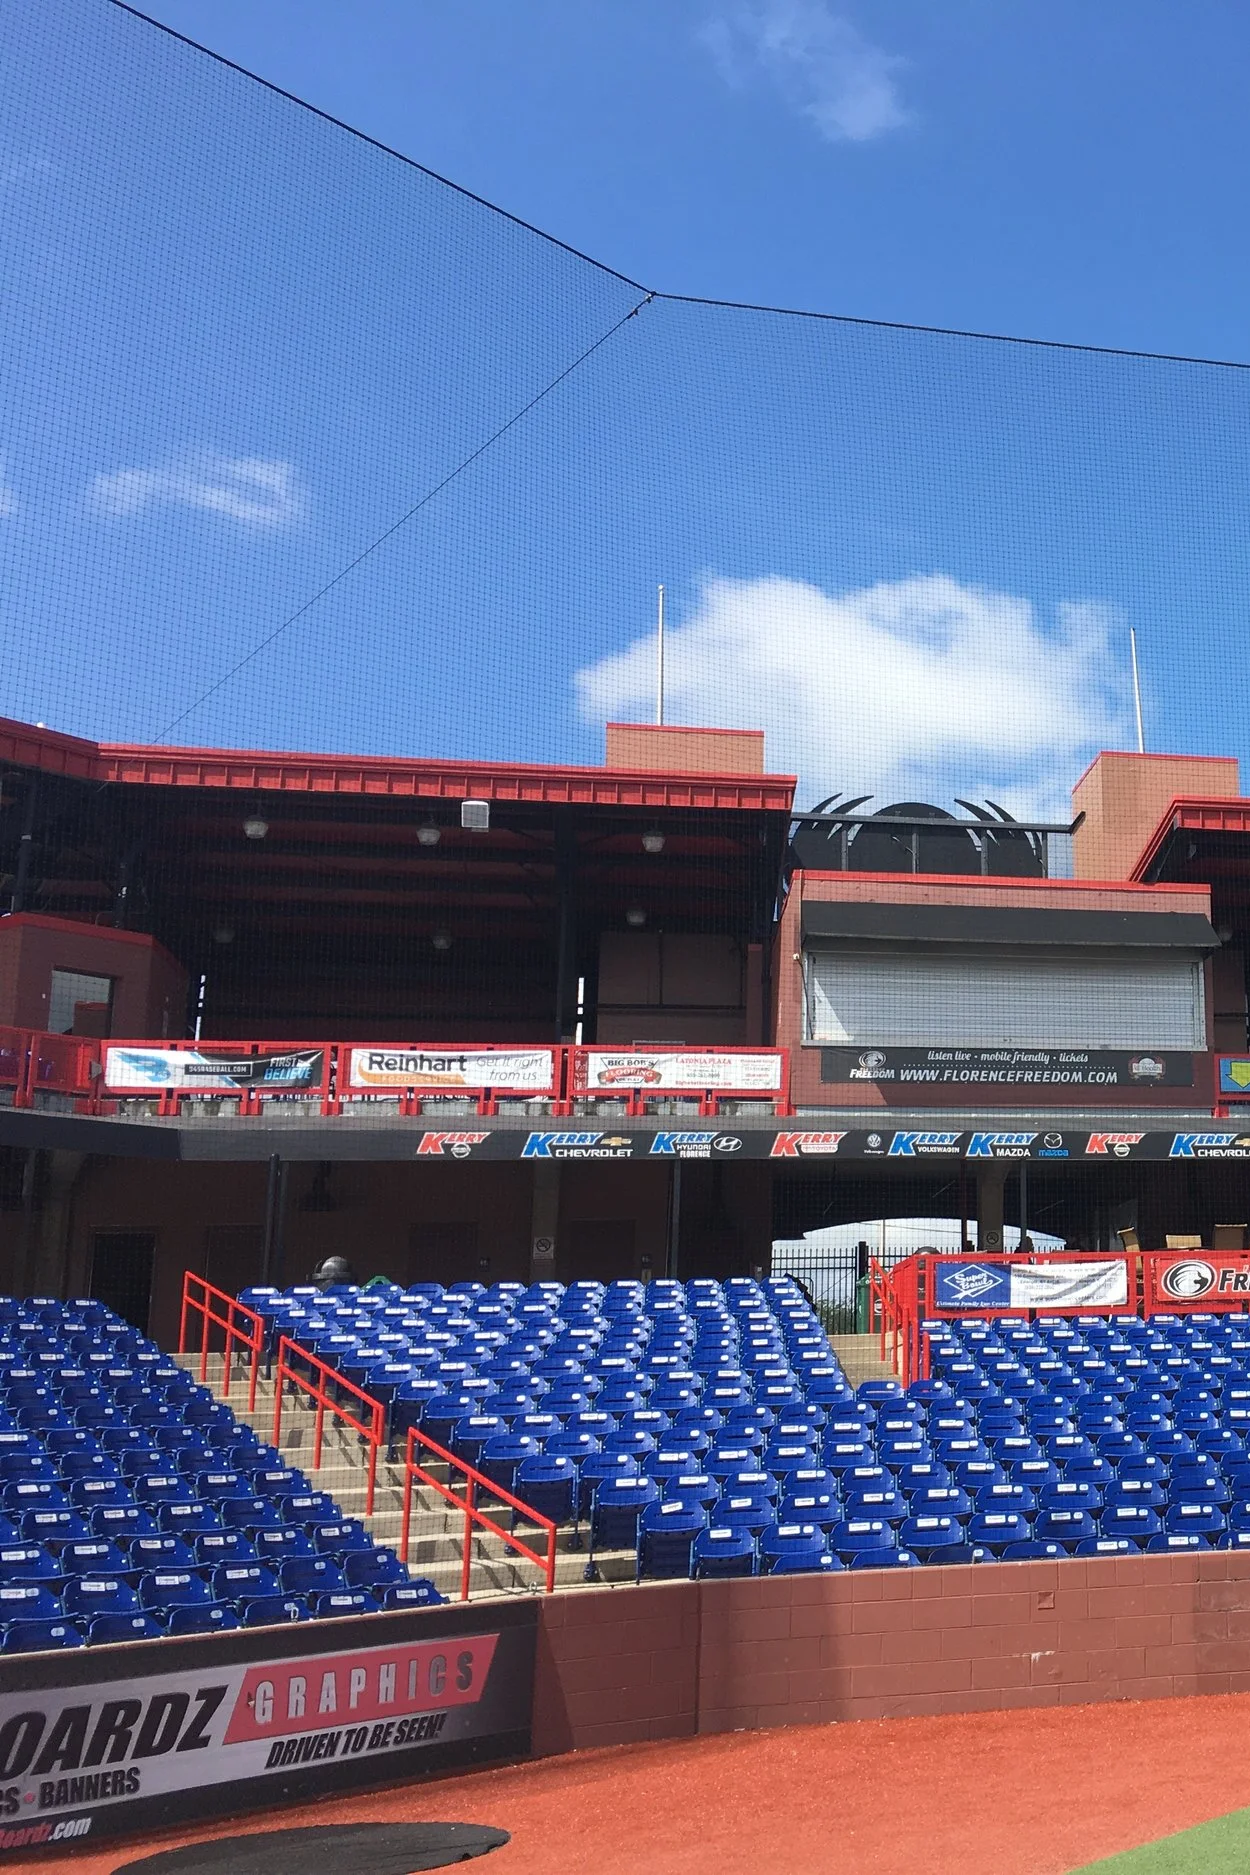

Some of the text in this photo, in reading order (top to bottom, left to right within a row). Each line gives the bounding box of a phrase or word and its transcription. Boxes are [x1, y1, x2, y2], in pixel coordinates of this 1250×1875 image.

[269, 1057, 298, 1068] FIRST
[368, 1053, 467, 1072] Reinhart
[476, 1056, 498, 1067] Get
[514, 1056, 544, 1070] right
[927, 1051, 1089, 1065] listen live mobile friendly tickets
[263, 1067, 313, 1080] BELIEVE
[489, 1068, 537, 1081] from us
[605, 1068, 654, 1078] FLOORING
[849, 1069, 895, 1079] FREEDOM
[900, 1069, 1118, 1084] WWW.FLORENCEFREEDOM.COM
[416, 1131, 492, 1155] KERRY
[520, 1131, 608, 1158] KERRY
[649, 1131, 719, 1155] KERRY
[769, 1131, 849, 1157] KERRY
[886, 1131, 966, 1157] KERRY
[917, 1146, 960, 1154] VOLKSWAGEN
[964, 1131, 1042, 1158] KERRY
[1085, 1133, 1147, 1154] KERRY
[1168, 1132, 1240, 1158] KERRY
[555, 1149, 633, 1158] CHEVROLET
[679, 1150, 712, 1158] FLORENCE
[996, 1148, 1032, 1157] MAZDA
[954, 1272, 988, 1284] Super
[959, 1277, 990, 1290] Bowl
[254, 1650, 474, 1725] GRAPHICS
[264, 1712, 448, 1770] DRIVEN TO BE SEEN!
[38, 1766, 141, 1810] BANNERS
